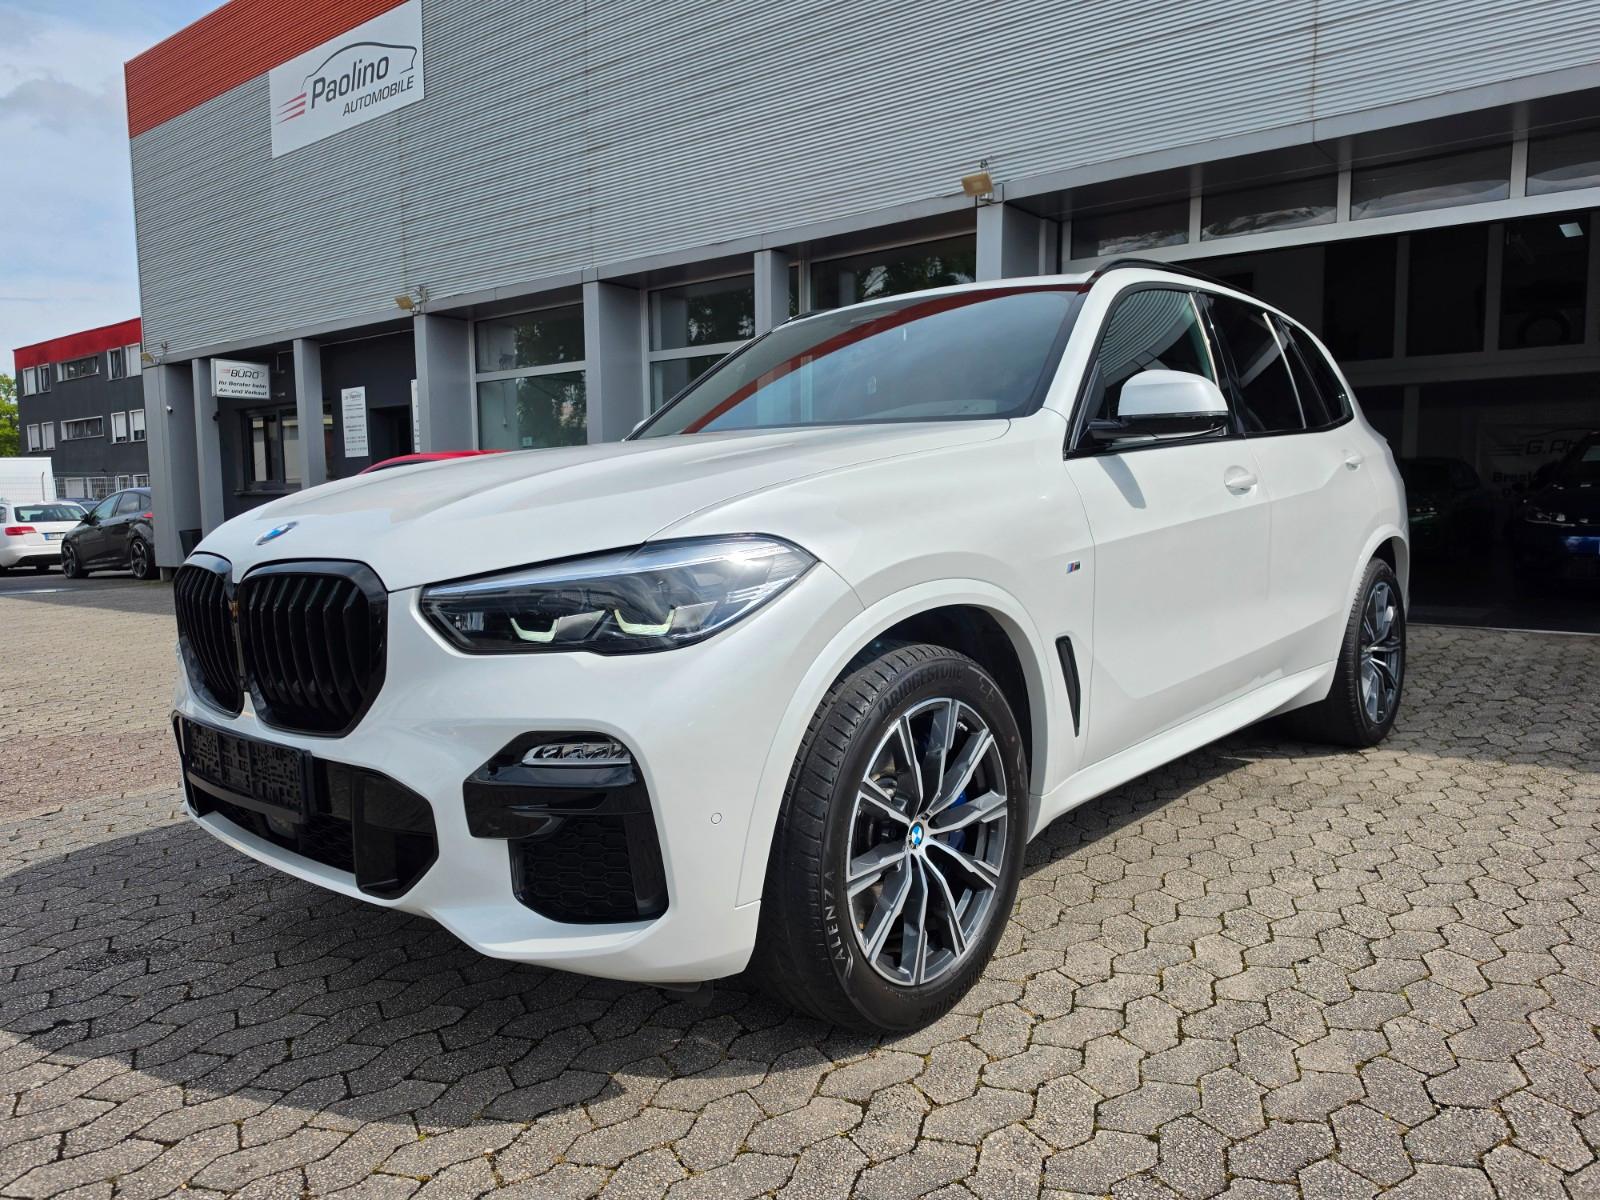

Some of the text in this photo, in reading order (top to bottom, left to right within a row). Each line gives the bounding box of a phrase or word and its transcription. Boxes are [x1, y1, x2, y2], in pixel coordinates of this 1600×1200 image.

[311, 56, 389, 109] Paolino
[342, 75, 415, 117] AUTOMOBILE
[230, 368, 260, 379] BÜRO
[823, 871, 846, 960] ALENZA
